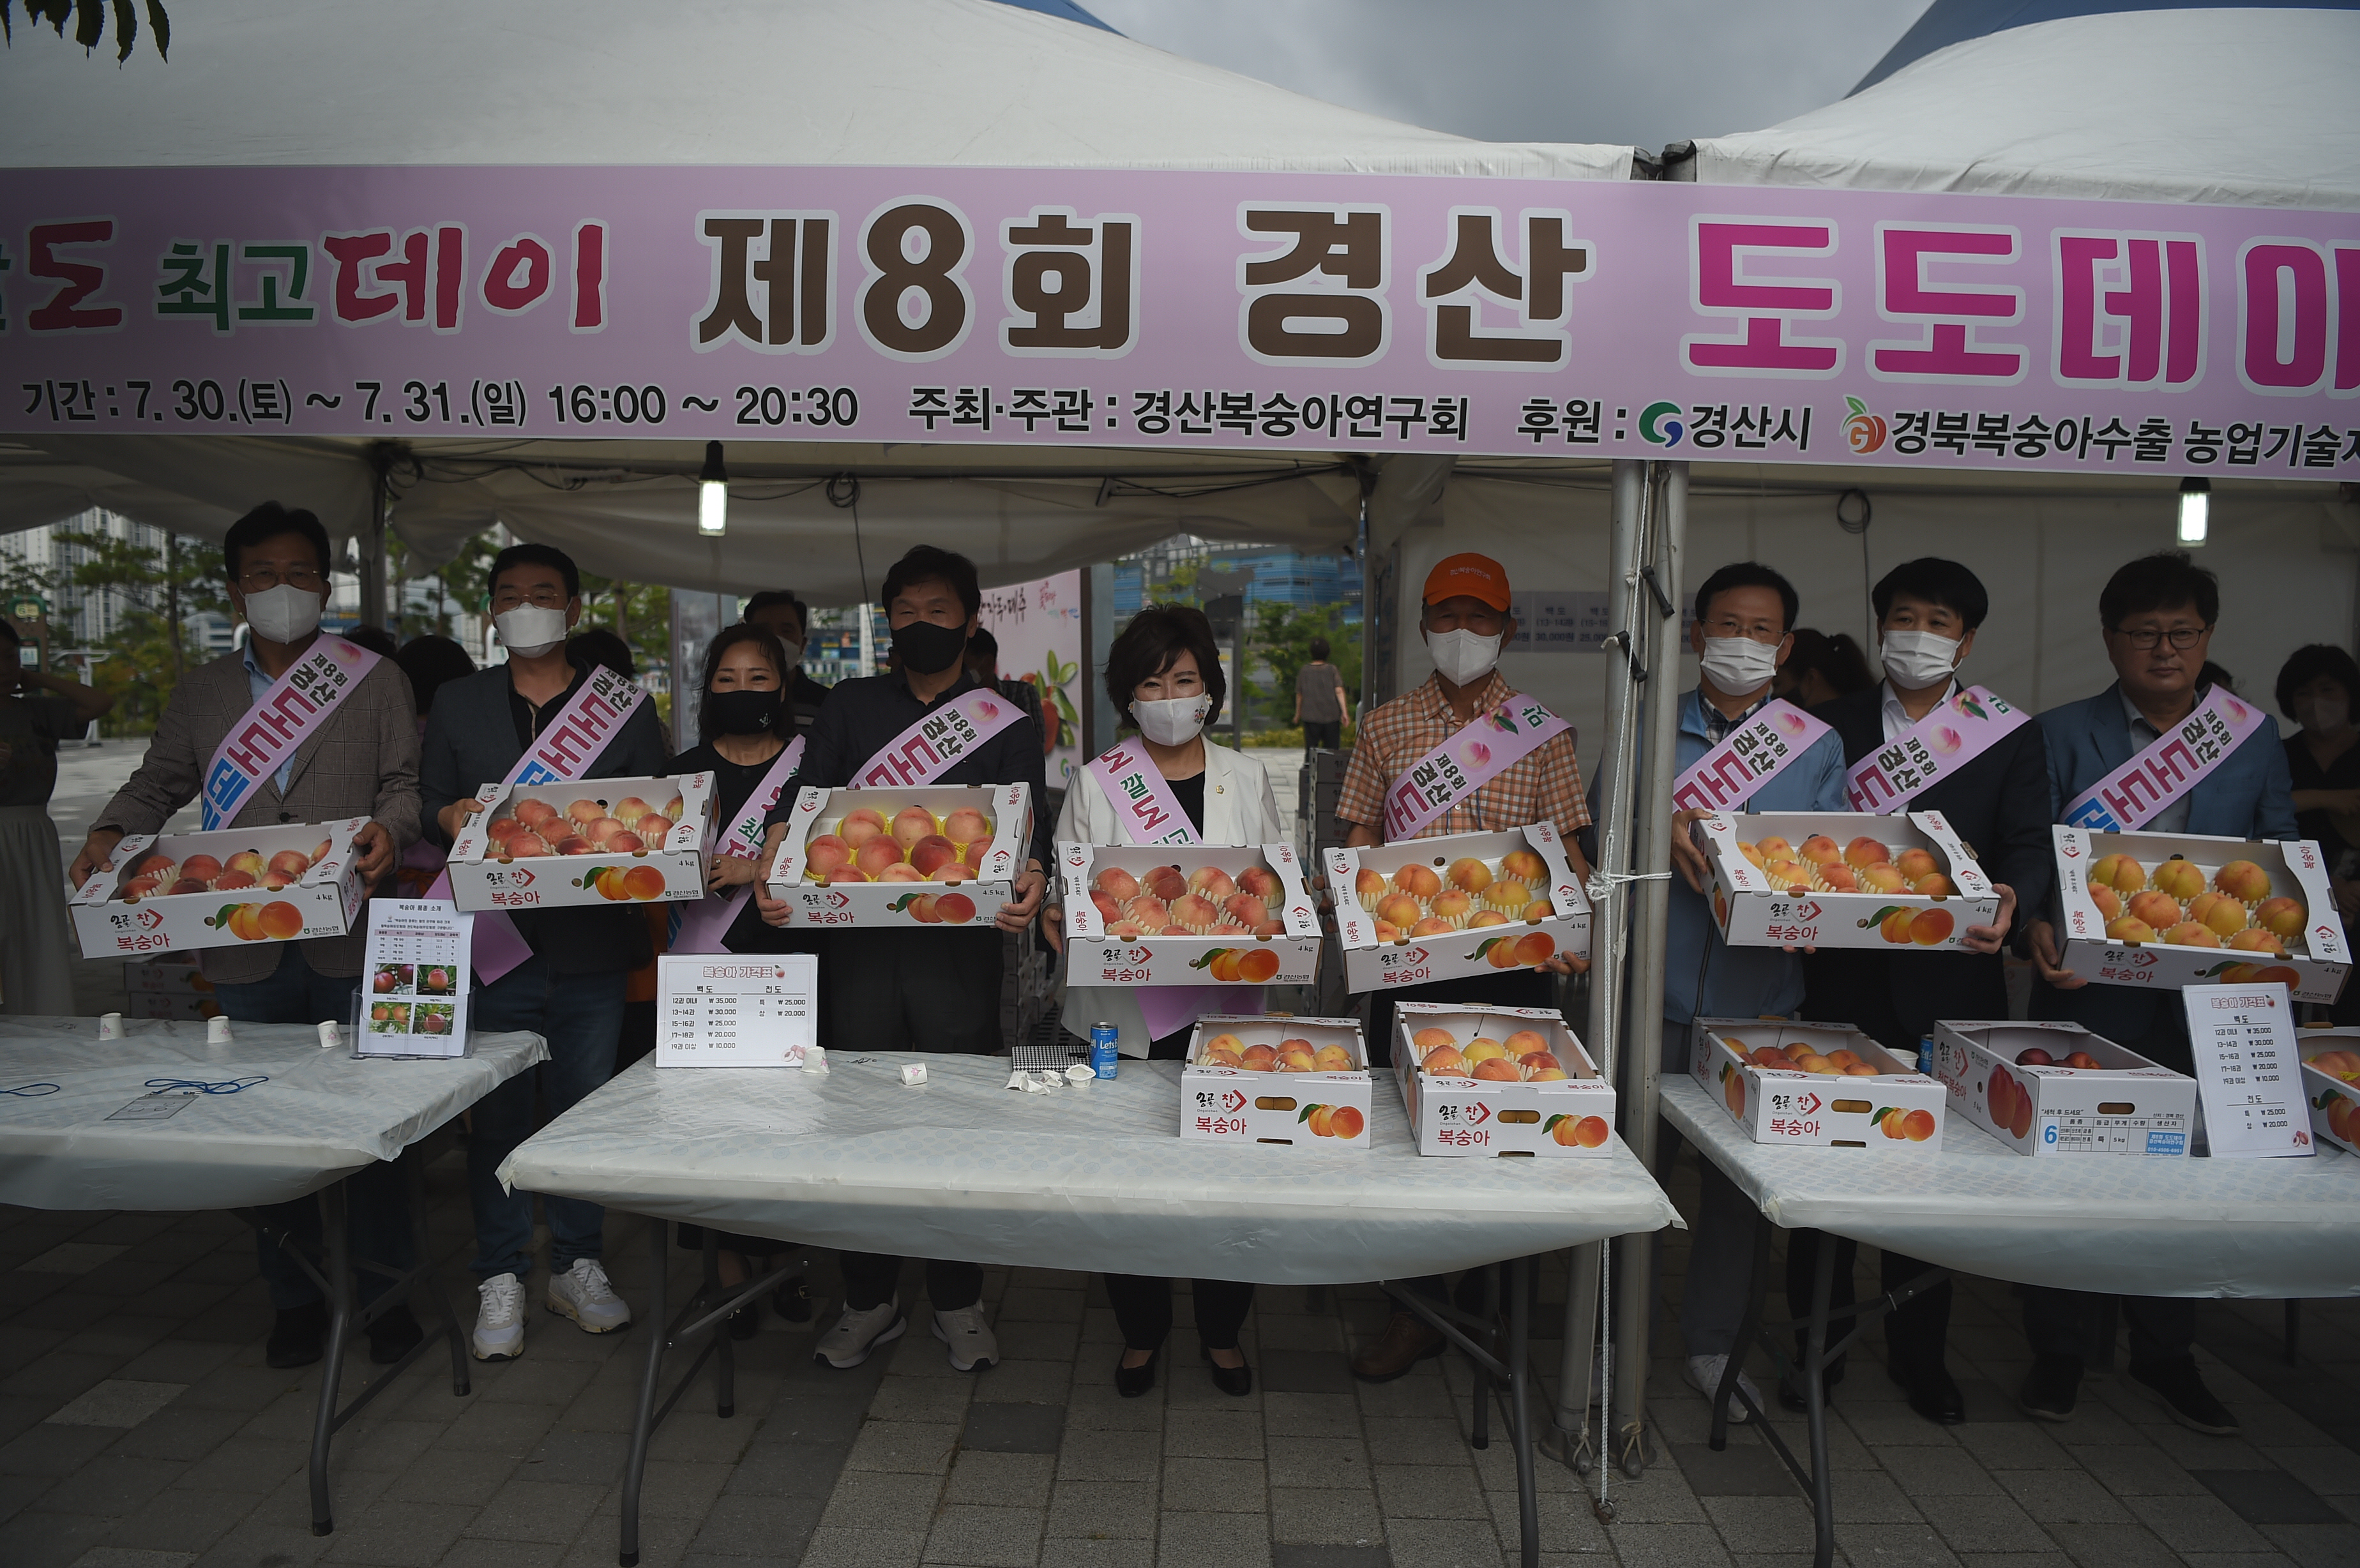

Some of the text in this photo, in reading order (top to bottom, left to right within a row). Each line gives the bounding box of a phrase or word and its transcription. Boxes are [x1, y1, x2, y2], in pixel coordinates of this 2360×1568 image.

[0, 204, 2360, 391] 도 최고데이 제8회 경산 도도데이
[548, 384, 666, 425] 16:00
[736, 386, 858, 426] 20:30
[1133, 388, 1468, 441] 경산복숭아연구회
[1690, 404, 1812, 450] 경산시
[1891, 409, 2172, 463] 경북복숭아수출
[290, 663, 337, 707] 경산
[312, 653, 348, 688] 제8회
[592, 674, 633, 712] 경산
[922, 715, 964, 760] 경산
[944, 709, 977, 743] 제8회
[1753, 722, 1789, 757] 제8회
[2182, 717, 2220, 764] 경산
[2204, 708, 2232, 746] 제8회
[1733, 729, 1776, 776] 경산
[1878, 744, 1921, 793] 경산
[1904, 737, 1937, 776] 제8회
[1412, 761, 1453, 807] 경산
[1435, 753, 1467, 790] 제8회
[491, 891, 540, 905] 복숭아
[808, 912, 854, 924] 복숭아
[1766, 925, 1818, 941] 복숭아
[117, 933, 170, 951] 복숭아
[704, 967, 773, 978] 복숭아 가격표
[1101, 969, 1151, 982] 복숭아
[1382, 967, 1430, 983] 복숭아
[2099, 967, 2154, 983] 복숭아
[2211, 997, 2265, 1009] 복숭아 가격표
[1195, 1117, 1246, 1135] 복숭아
[1438, 1129, 1490, 1147] 복숭아
[1769, 1119, 1820, 1137] 복숭아
[2045, 1126, 2057, 1143] 6
